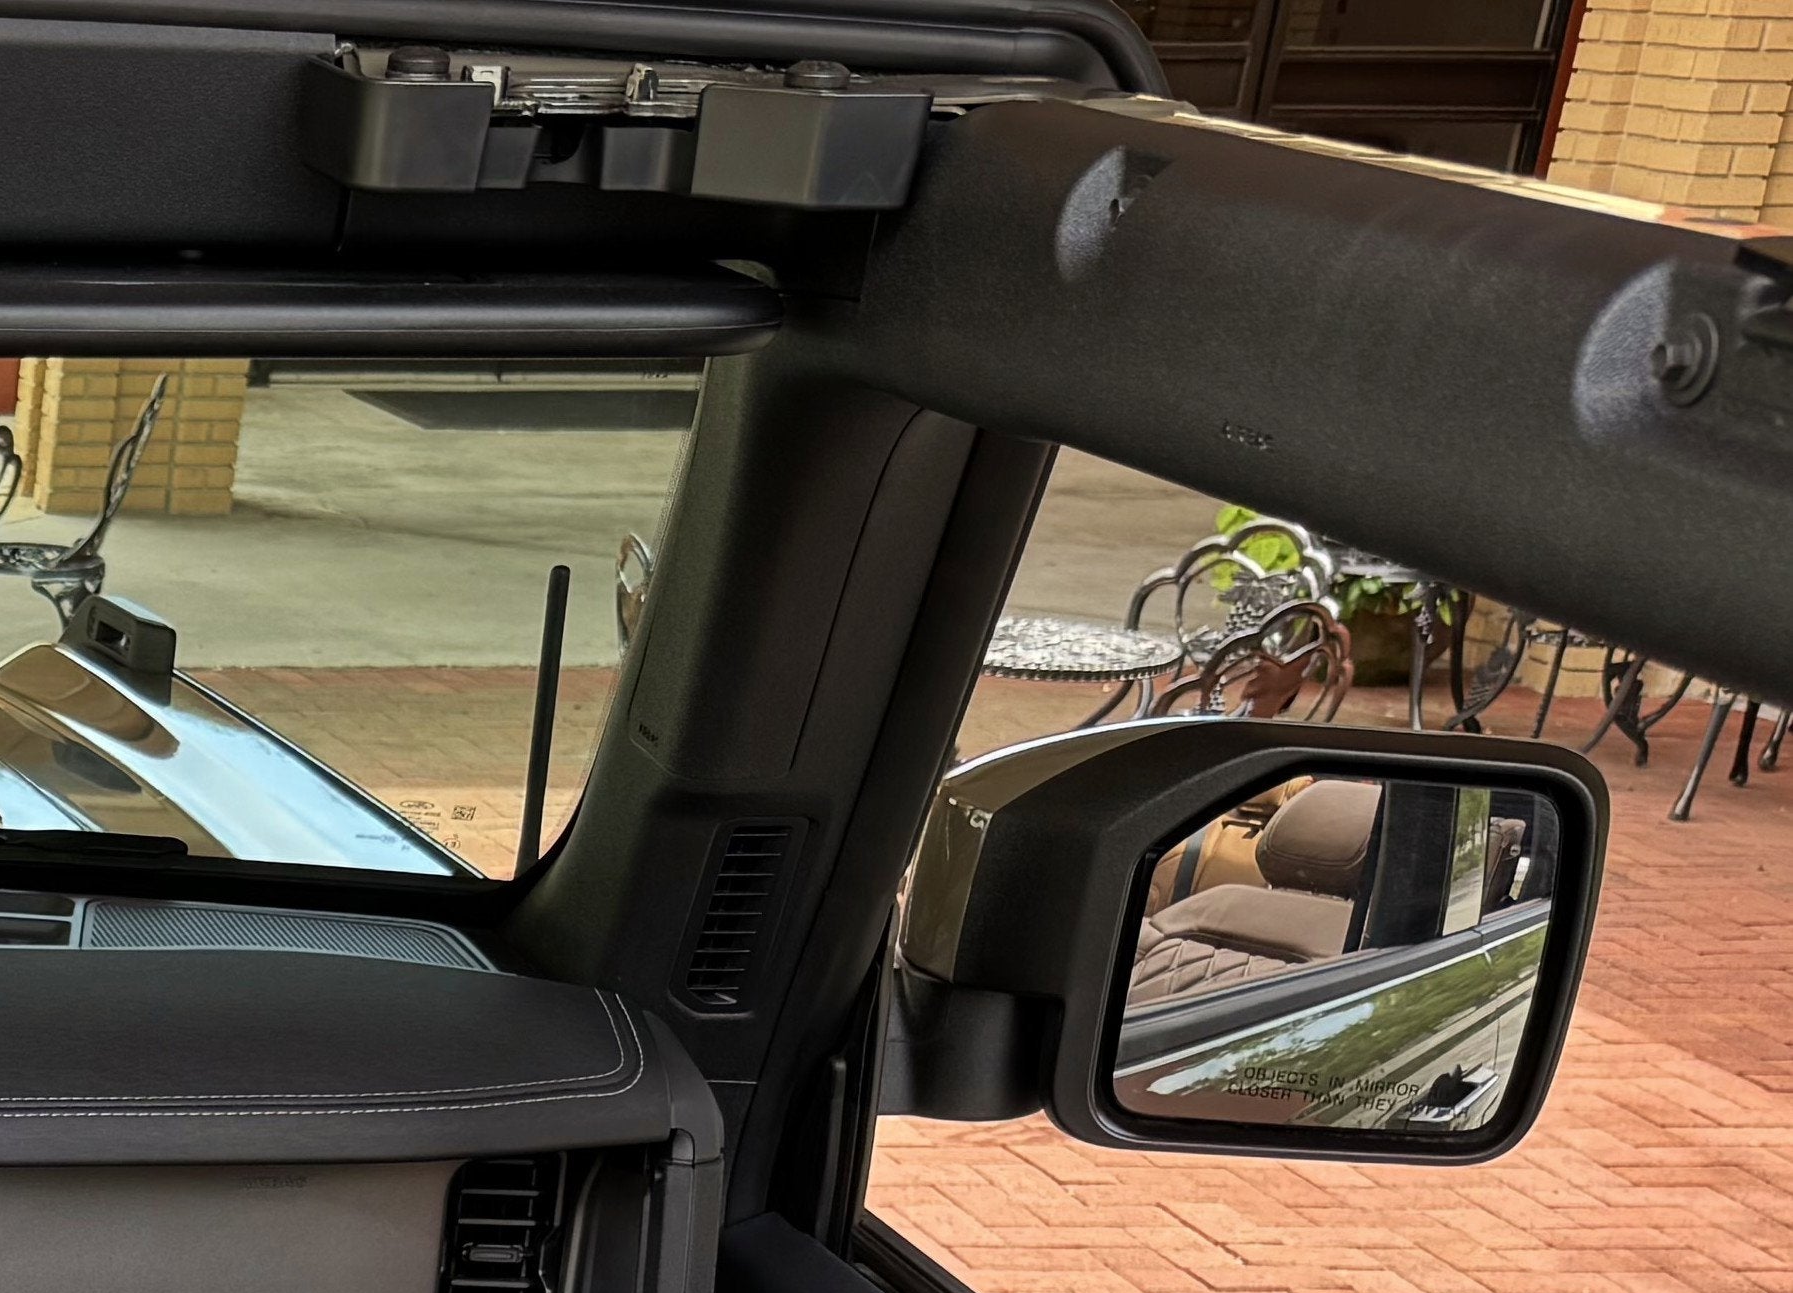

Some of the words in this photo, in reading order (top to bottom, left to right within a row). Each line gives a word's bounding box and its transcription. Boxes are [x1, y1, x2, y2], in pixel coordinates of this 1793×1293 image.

[1227, 1082, 1291, 1100] CLOSER
[1302, 1090, 1345, 1106] THAN
[1357, 1097, 1397, 1112] THEY
[1244, 1067, 1318, 1086] OBJECTS
[1329, 1076, 1345, 1089] IN
[1356, 1079, 1419, 1097] MIRROR
